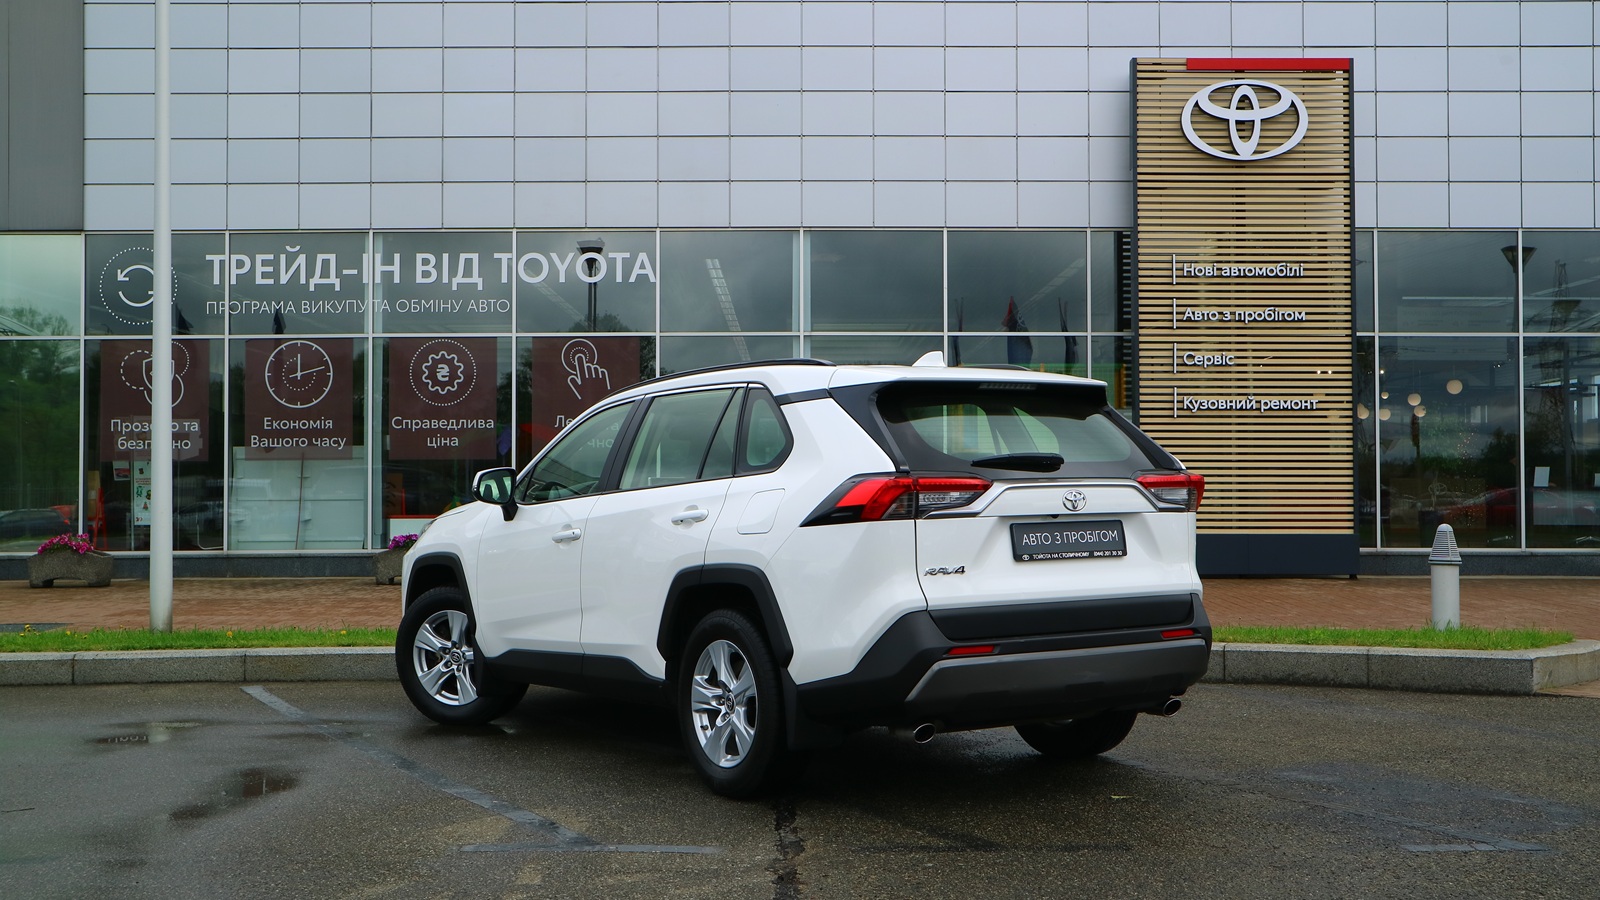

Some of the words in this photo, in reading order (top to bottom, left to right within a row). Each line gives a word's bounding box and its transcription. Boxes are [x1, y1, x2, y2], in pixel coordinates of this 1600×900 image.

[205, 245, 400, 292] ТРЕЙД-ІН
[415, 252, 483, 291] ВІД
[493, 252, 656, 284] TOYOTA
[1183, 263, 1217, 277] Нові
[1221, 263, 1304, 277] автомобілі
[206, 301, 296, 315] ПРОГРАМА
[301, 300, 367, 315] ВИКУПУ
[373, 299, 391, 313] ТА
[395, 299, 463, 314] ОБМІНУ
[466, 299, 510, 313] АВТО
[1183, 307, 1219, 321] Авто
[1222, 310, 1231, 321] з
[1235, 307, 1306, 324] пробігом
[1183, 352, 1235, 368] Сервіс
[1183, 396, 1256, 413] Кузовний
[1260, 399, 1319, 413] ремонт
[110, 420, 179, 434] Прозо
[183, 421, 199, 431] та
[263, 417, 333, 430] Економія
[391, 416, 494, 432] Справедлива
[117, 437, 191, 449] безпно
[250, 435, 308, 448] Вашого
[312, 437, 346, 450] часу
[427, 435, 459, 448] ціна
[1022, 531, 1052, 546] АВТО
[1063, 529, 1119, 544] ПРОБІГОМ
[924, 565, 966, 576] RAV4
